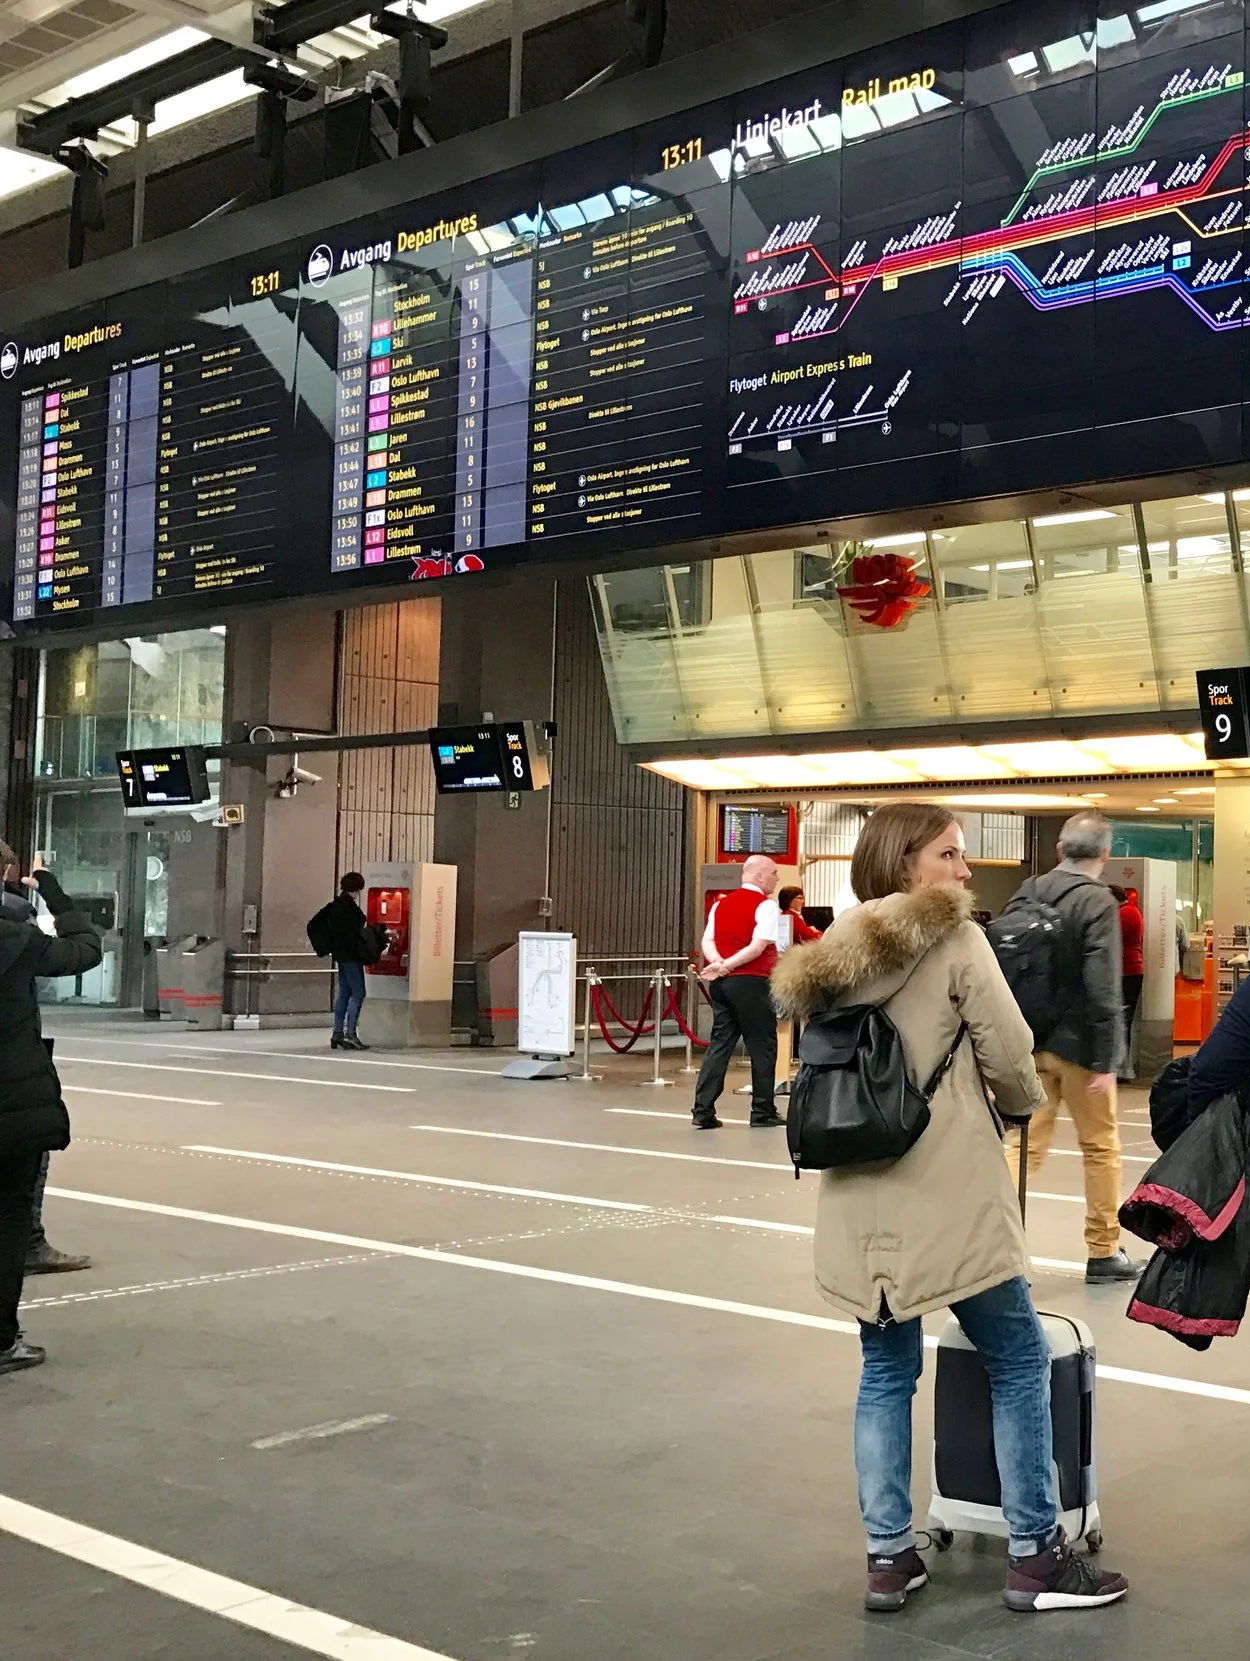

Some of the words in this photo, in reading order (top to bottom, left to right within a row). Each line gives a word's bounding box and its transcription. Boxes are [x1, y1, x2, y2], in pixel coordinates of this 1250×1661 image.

[736, 99, 821, 147] Linjekart
[841, 78, 879, 108] Rail
[888, 68, 935, 97] map
[661, 138, 702, 170] 13:11
[340, 240, 391, 270] Avgang
[397, 213, 477, 253] Departures
[251, 270, 279, 296] 13:11
[393, 294, 431, 312] Stockholm
[469, 278, 479, 291] 15
[393, 311, 437, 331] Lillehammer
[468, 298, 477, 311] 11
[538, 279, 551, 290] NSB
[23, 341, 60, 365] Avgang
[64, 322, 122, 352] Departures
[393, 336, 404, 349] Ski
[472, 317, 478, 329] 9
[391, 374, 407, 388] Oslo
[409, 368, 440, 384] Lufthavn
[467, 357, 476, 369] 13
[536, 337, 560, 352] Flytoget
[392, 354, 413, 369] Larvik
[471, 338, 477, 349] 5
[730, 374, 767, 394] Flytoget
[771, 366, 804, 384] Airport
[807, 359, 845, 376] Express
[848, 353, 872, 368] Train
[391, 387, 429, 408] Spikkestad
[470, 376, 476, 387] 7
[390, 408, 425, 425] Lillestrøm
[470, 396, 476, 407] 9
[340, 442, 359, 455] 13:42
[389, 433, 408, 448] Jaren
[465, 417, 475, 428] 16
[534, 400, 547, 412] NSB
[389, 451, 401, 464] Dal
[464, 436, 473, 448] 11
[339, 479, 358, 492] 13:47
[388, 467, 416, 482] Stabekk
[468, 455, 474, 467] 8
[337, 516, 357, 529] 13:50
[387, 508, 403, 521] Oslo
[404, 504, 435, 518] Lufthavn
[463, 496, 472, 507] 13
[532, 481, 557, 495] Flytoget
[338, 497, 358, 510] 13:49
[388, 486, 422, 501] Drammen
[467, 475, 473, 486] 5
[337, 536, 357, 548] 13:54
[387, 525, 414, 540] Eidsvoll
[462, 515, 471, 527] 11
[532, 503, 545, 514] NSB
[336, 554, 356, 567] 13:56
[386, 544, 421, 558] Lillestrøm
[466, 535, 472, 546] 9
[1208, 684, 1228, 696] Spor
[1209, 694, 1233, 706] Track
[506, 733, 519, 742] Spor
[1215, 714, 1232, 743] 9
[508, 741, 522, 750] Track
[512, 756, 524, 778] 8
[126, 778, 133, 797] 7
